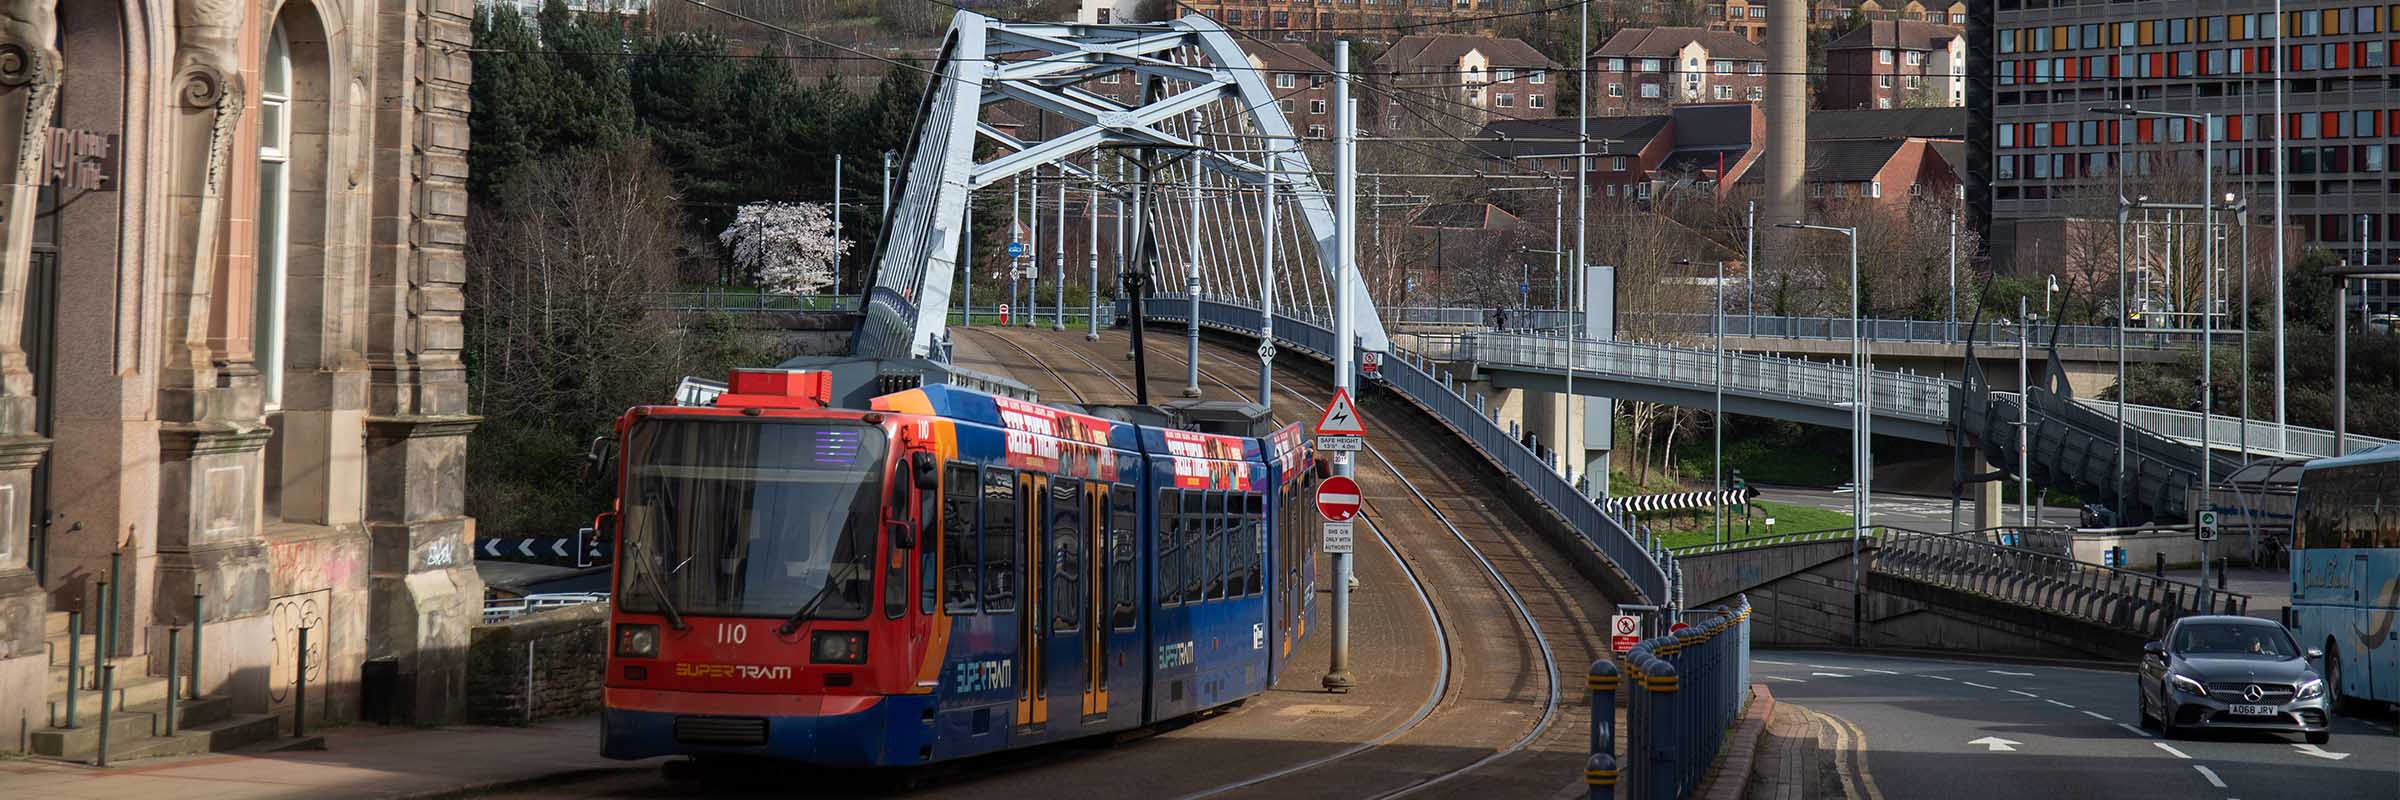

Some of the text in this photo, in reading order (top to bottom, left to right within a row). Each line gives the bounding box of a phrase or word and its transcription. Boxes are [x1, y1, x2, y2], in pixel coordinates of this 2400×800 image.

[1261, 346, 1275, 358] 20
[918, 419, 929, 440] 110
[718, 623, 747, 644] 110
